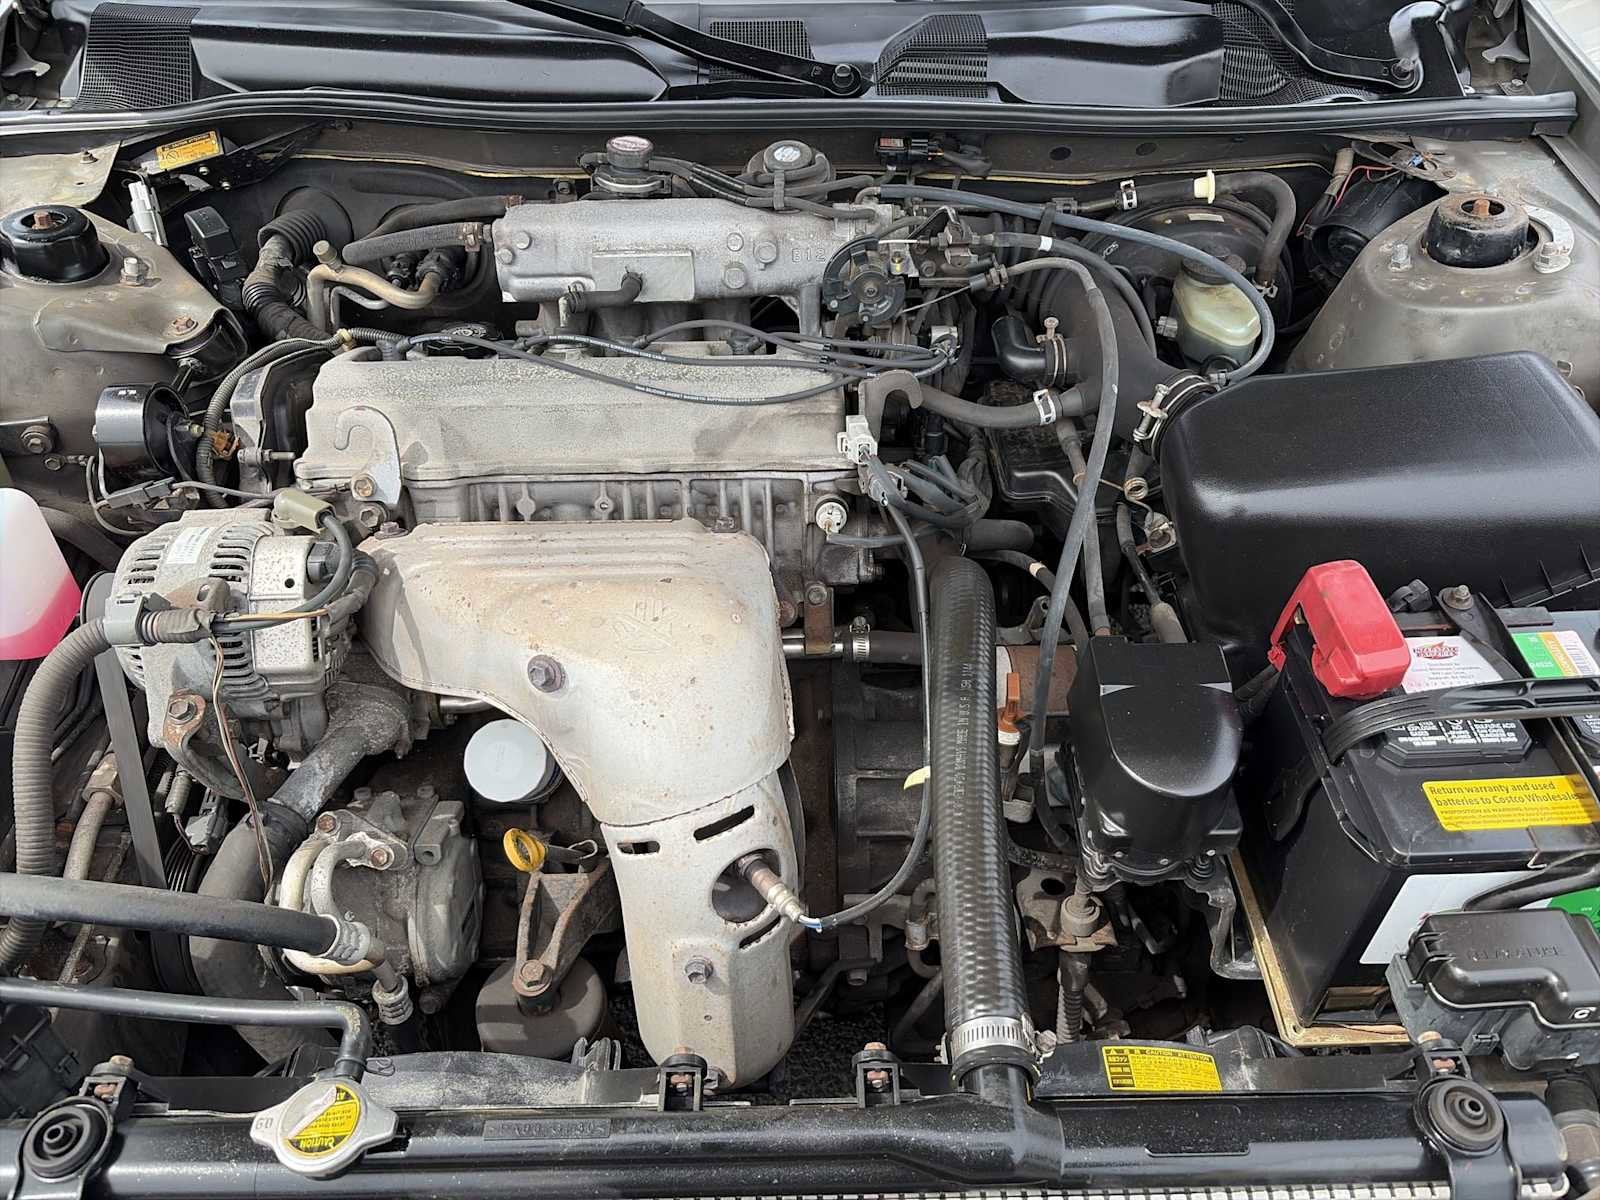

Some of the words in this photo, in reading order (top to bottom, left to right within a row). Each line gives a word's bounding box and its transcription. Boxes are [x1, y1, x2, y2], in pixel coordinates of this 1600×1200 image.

[1429, 785, 1464, 795] Return
[1465, 784, 1510, 795] warranty
[1511, 782, 1530, 792] and
[1531, 781, 1556, 790] used
[1434, 797, 1481, 807] batteries
[1482, 796, 1492, 805] to
[1493, 795, 1525, 804] Costco
[300, 1137, 335, 1149] CAUTION
